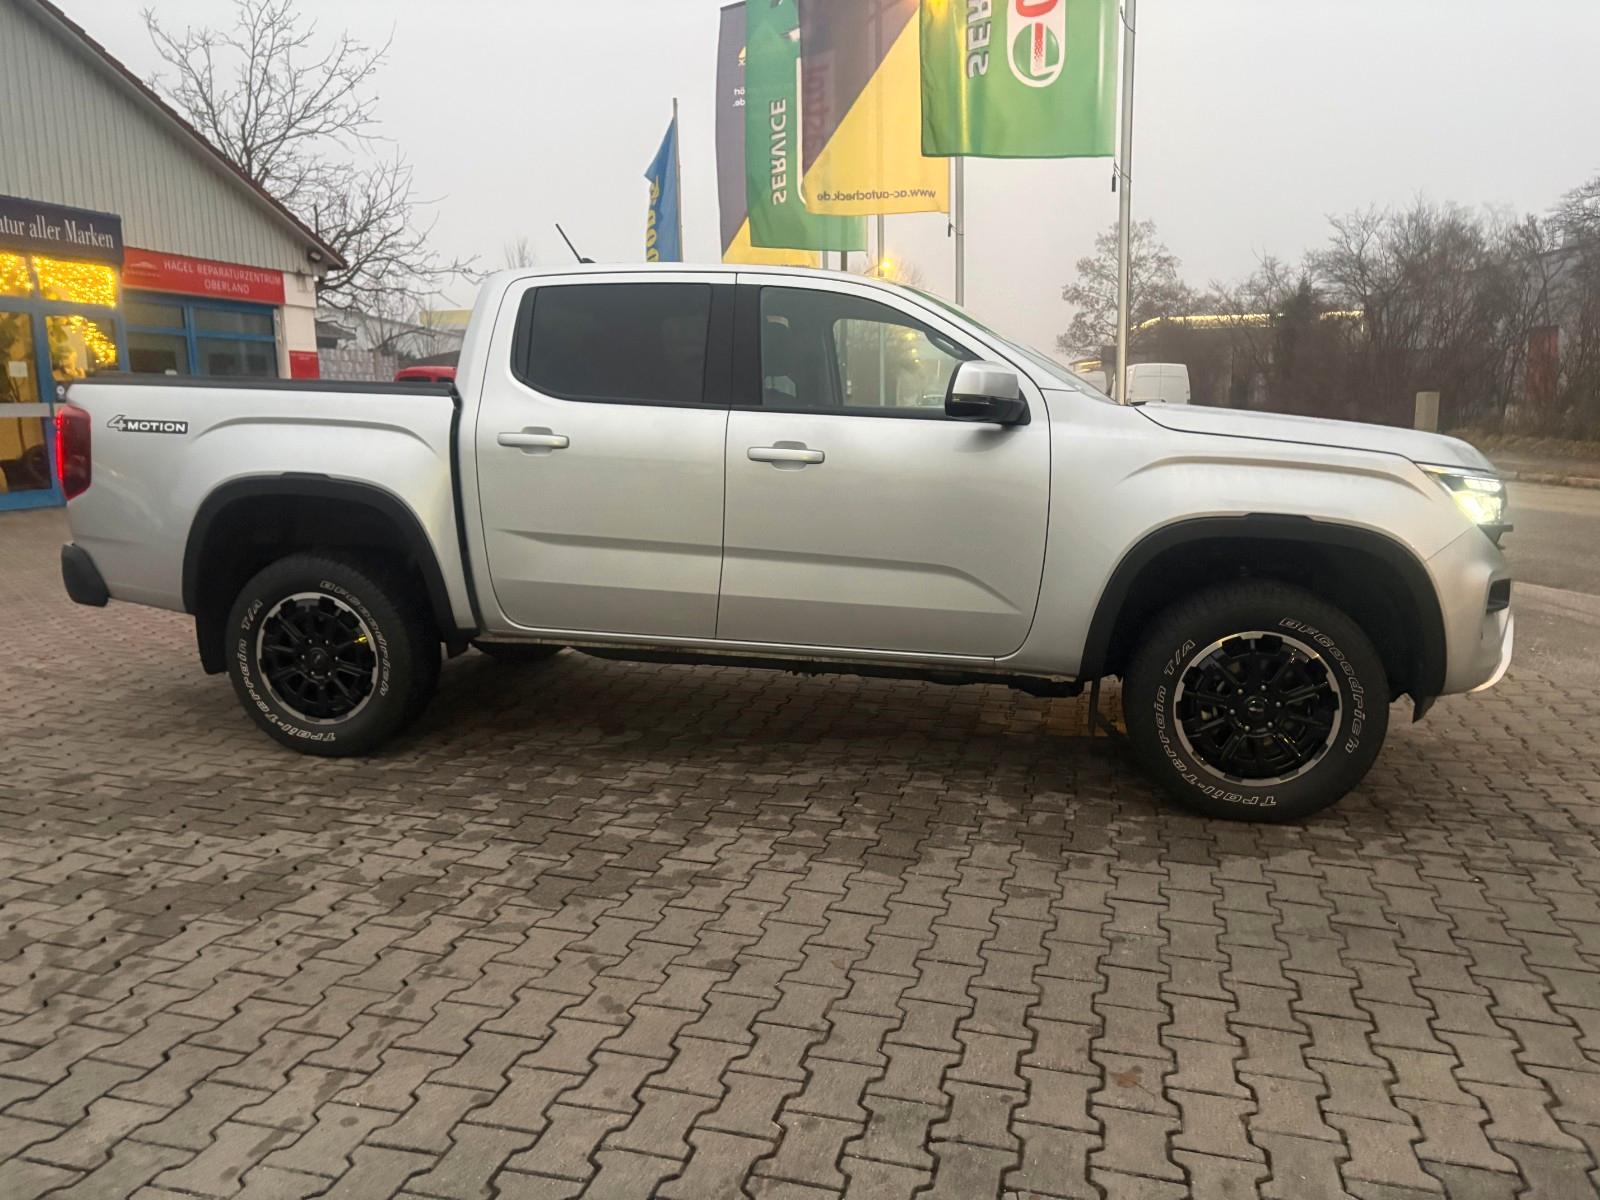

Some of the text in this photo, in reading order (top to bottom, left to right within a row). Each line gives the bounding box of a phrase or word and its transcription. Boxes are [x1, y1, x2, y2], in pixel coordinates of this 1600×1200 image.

[29, 214, 61, 241] aller
[64, 219, 114, 249] Marken
[163, 260, 194, 274] HAGEL
[196, 262, 282, 286] REPARATURZENTRUM
[204, 279, 251, 295] OBERLAND
[106, 414, 187, 433] 4MOTION
[1278, 616, 1366, 754] BFGoodrich
[1153, 639, 1277, 807] Trail-Terrain T/A
